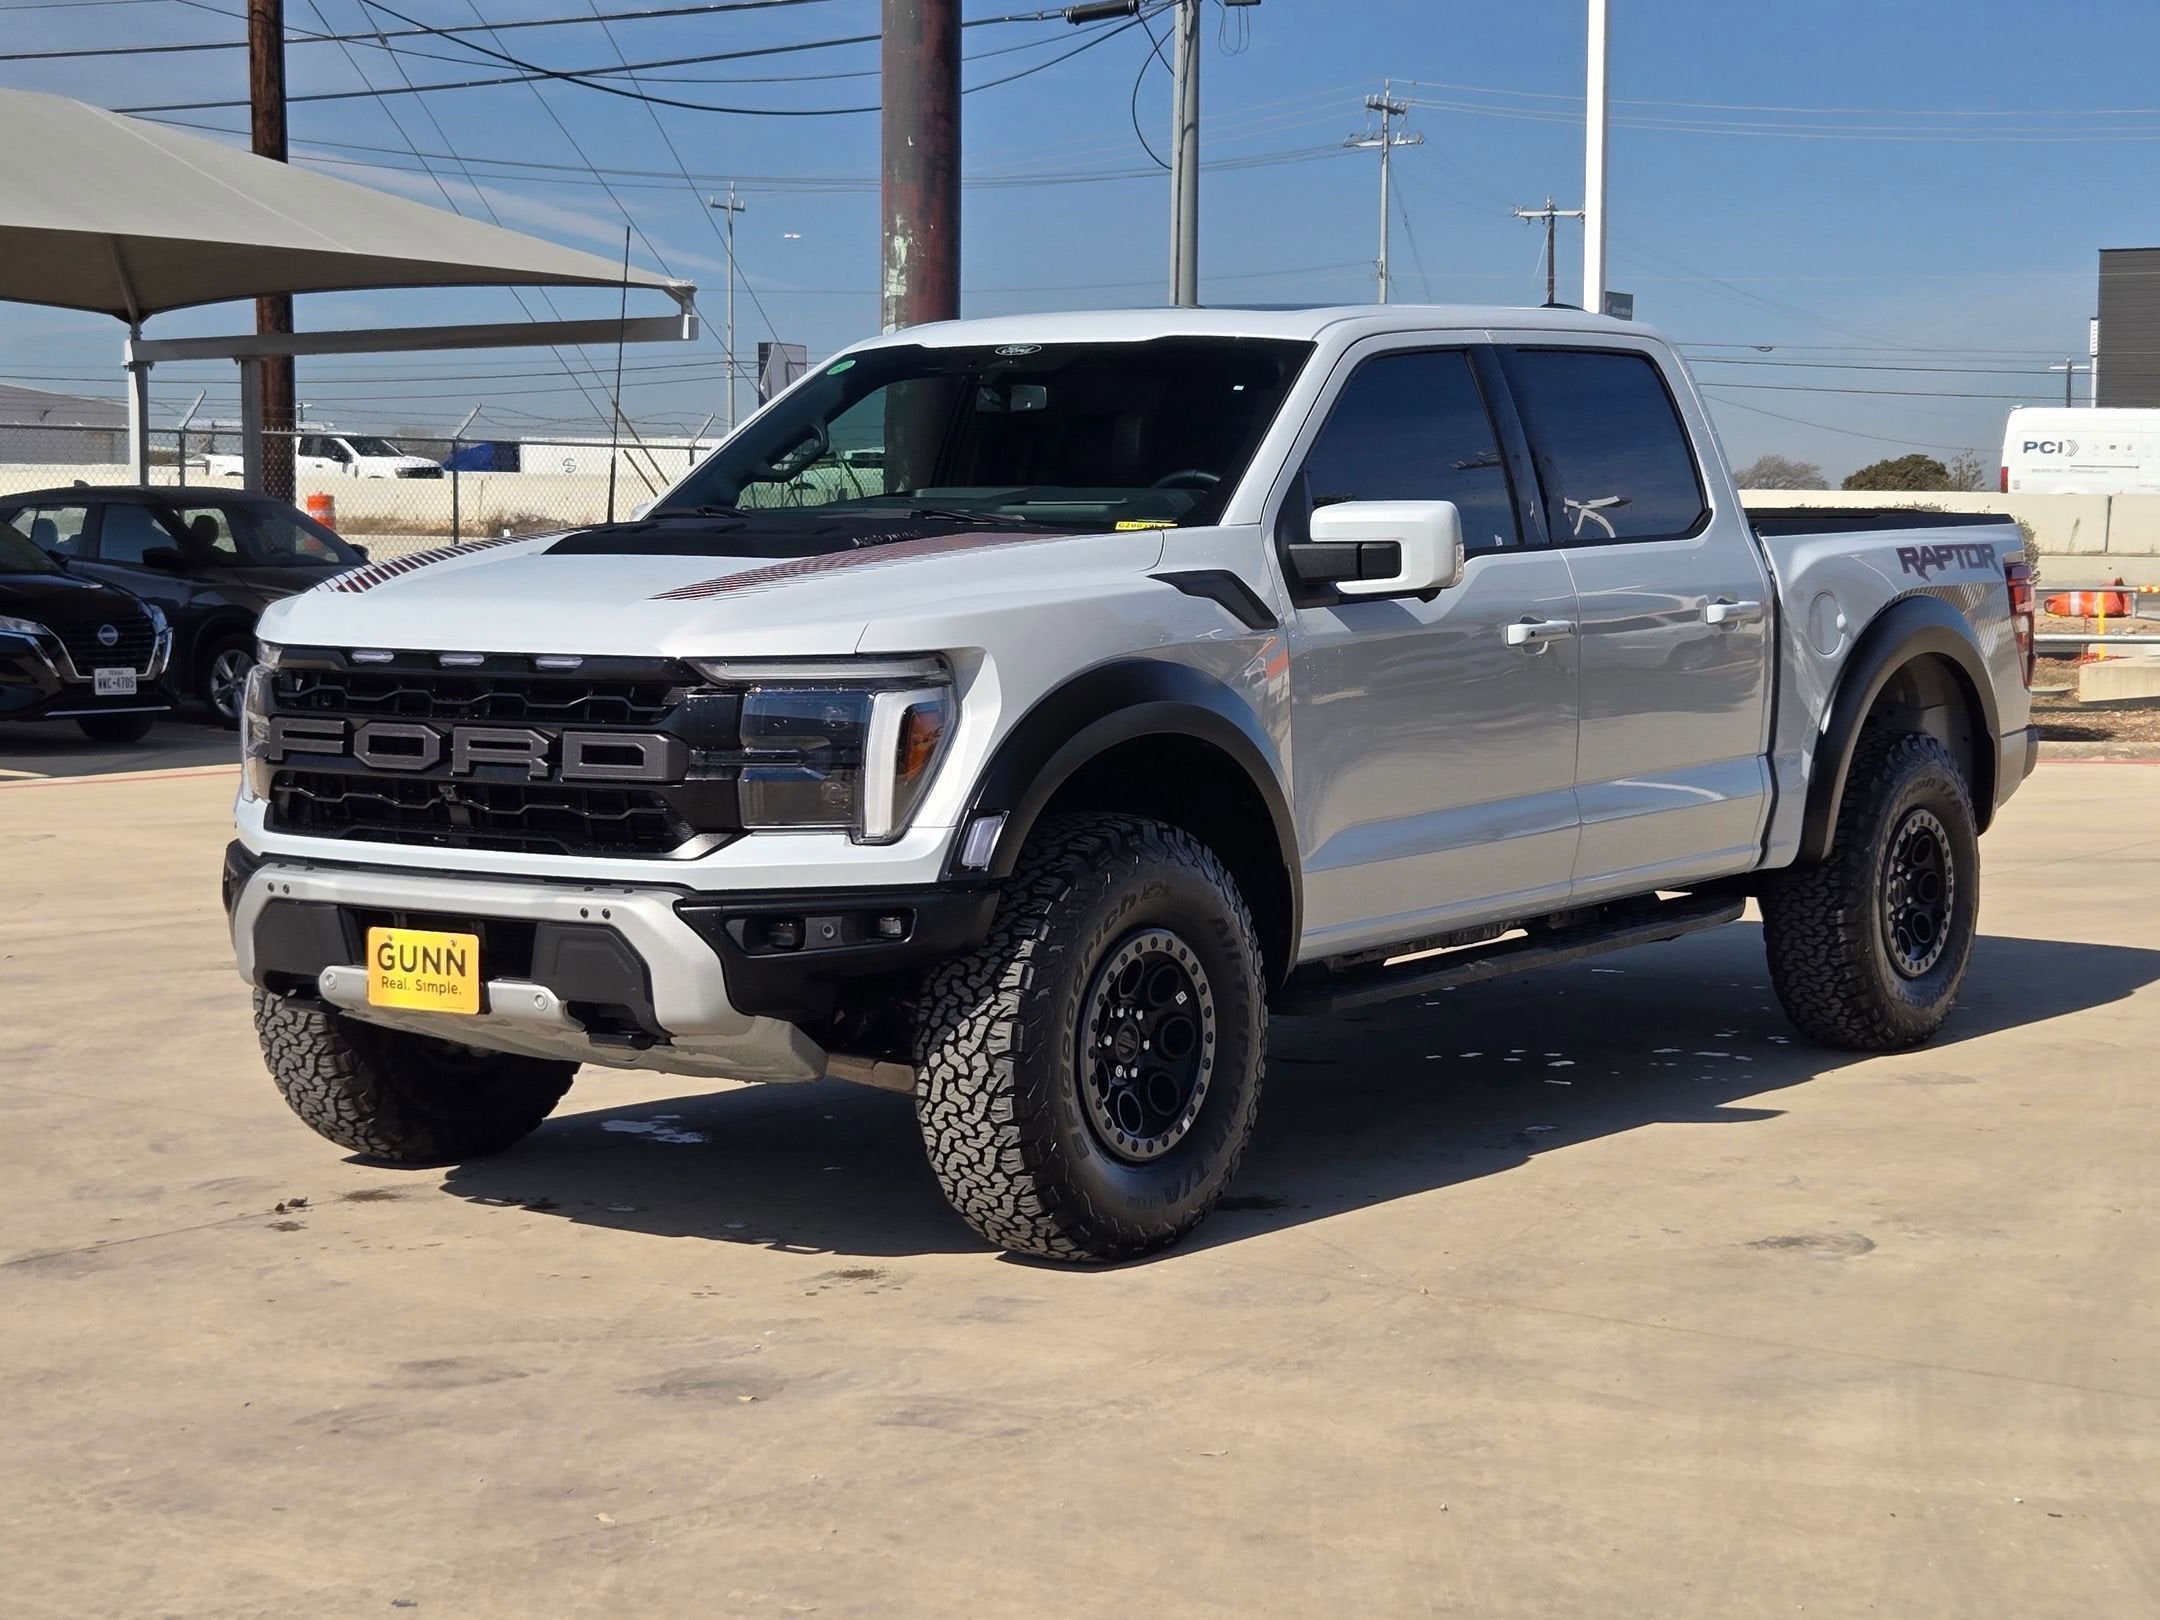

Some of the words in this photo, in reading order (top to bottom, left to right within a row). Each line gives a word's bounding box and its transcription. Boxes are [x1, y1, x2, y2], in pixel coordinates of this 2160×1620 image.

[2022, 441, 2063, 455] PCI
[1896, 543, 2004, 583] RAPTOR
[268, 717, 686, 783] FORD
[377, 942, 466, 978] GUNN
[381, 975, 411, 991] Real.
[415, 979, 462, 996] Simple.
[1061, 891, 1137, 1160] BFGoodrich
